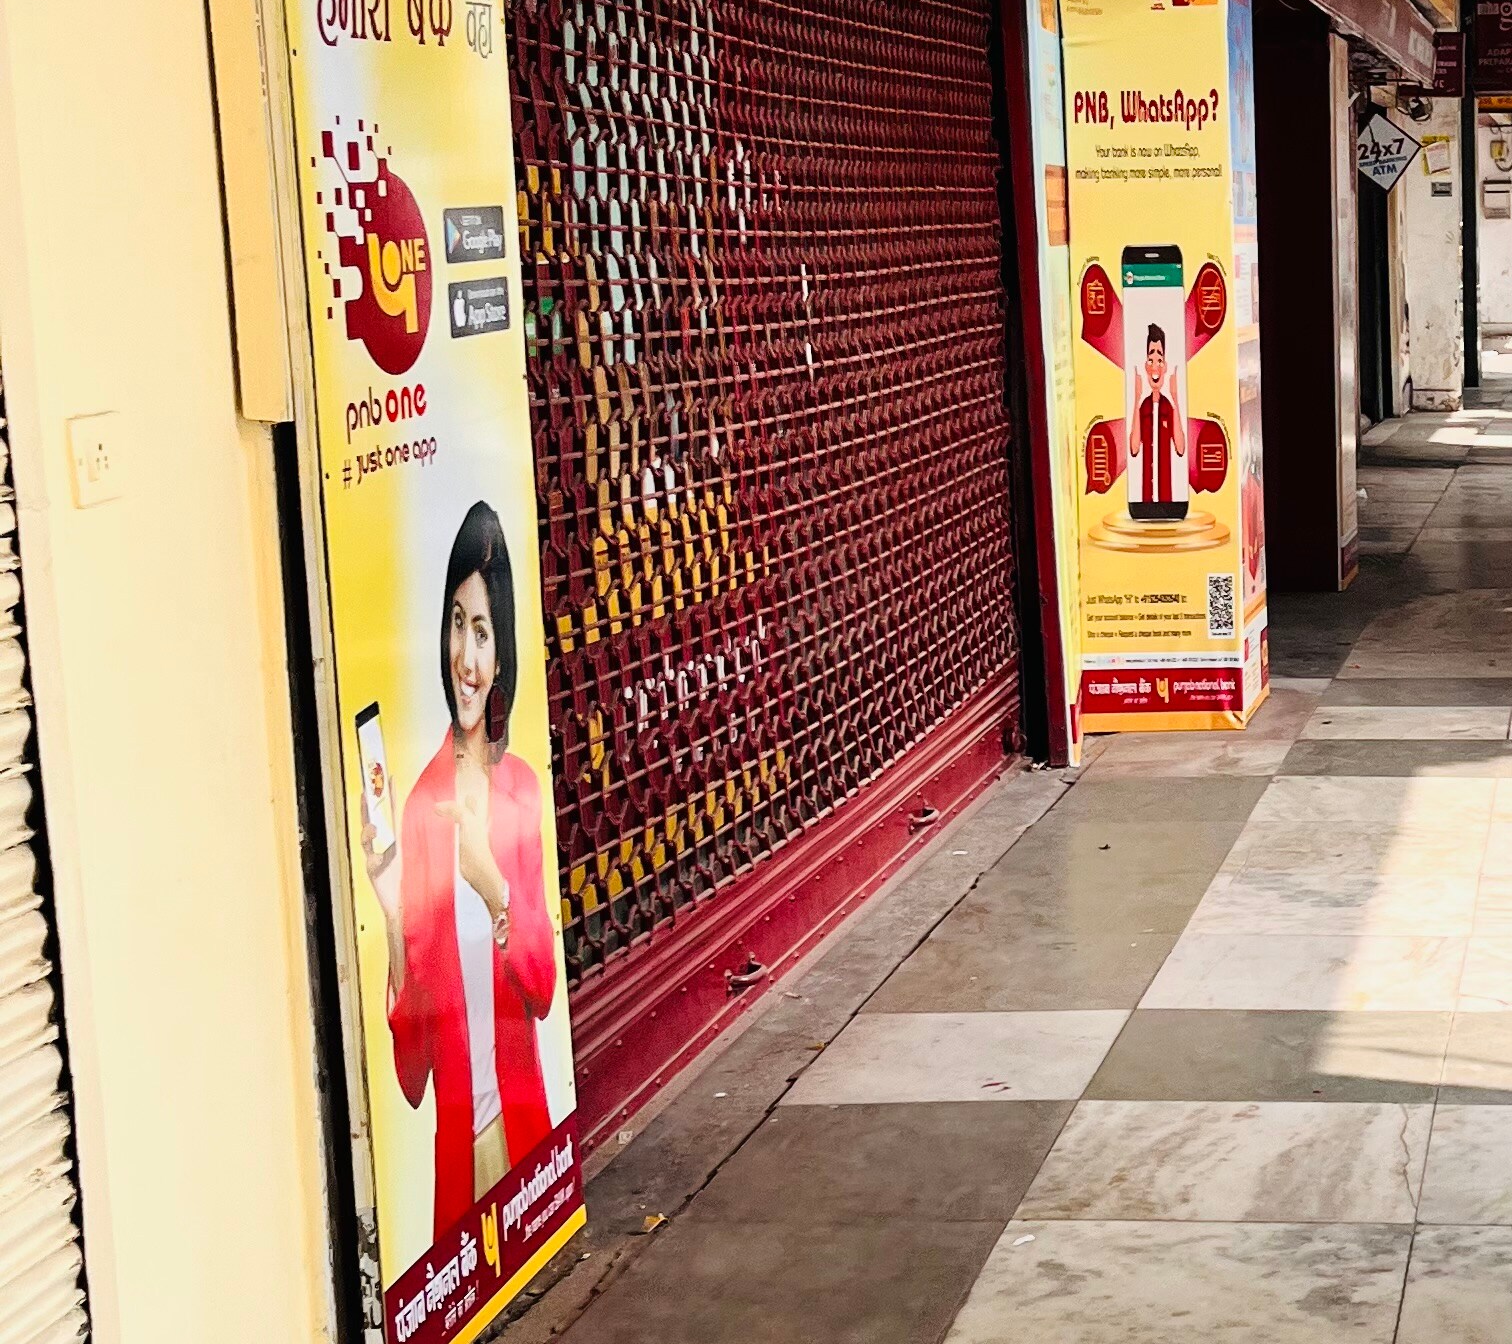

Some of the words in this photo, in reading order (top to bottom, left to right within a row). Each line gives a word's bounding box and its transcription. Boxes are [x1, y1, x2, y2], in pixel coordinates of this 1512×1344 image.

[1074, 90, 1115, 130] PNB,
[1120, 88, 1219, 131] WhatsApp?
[1095, 144, 1111, 158] Your
[1111, 144, 1129, 158] bank
[1130, 145, 1137, 158] is
[1138, 147, 1153, 158] now
[1153, 147, 1163, 158] on
[1357, 138, 1405, 161] 24x7
[1075, 167, 1100, 183] making
[1101, 166, 1128, 183] banking
[1129, 168, 1147, 179] more
[1173, 167, 1190, 179] more
[1372, 164, 1398, 176] ATM
[346, 386, 382, 445] pnb
[386, 383, 428, 424] one
[354, 444, 382, 485] just
[385, 440, 411, 466] one
[412, 436, 438, 467] app
